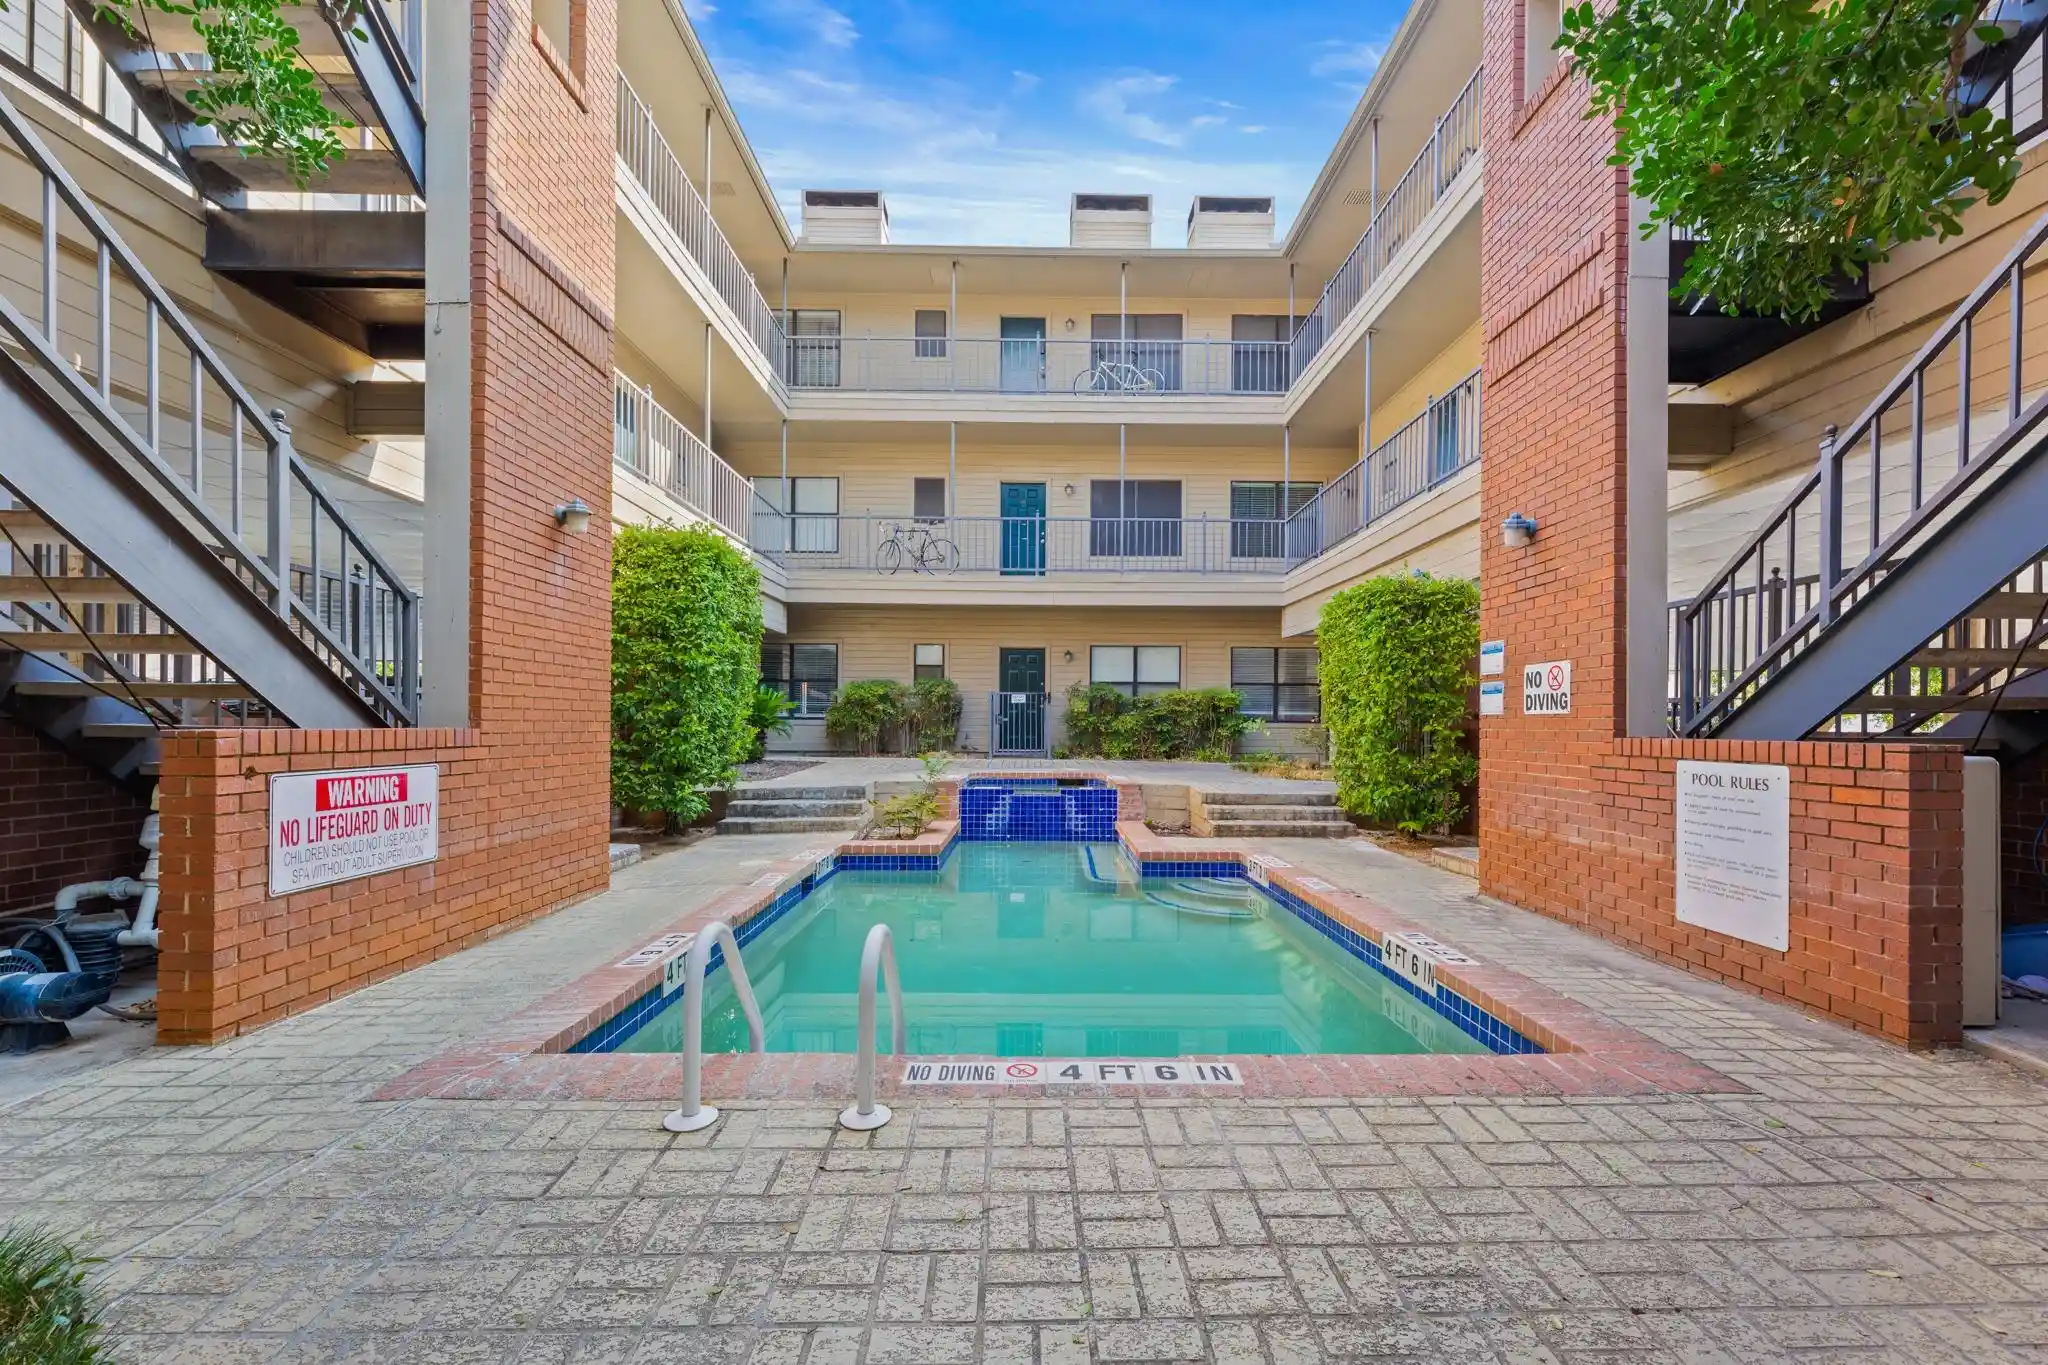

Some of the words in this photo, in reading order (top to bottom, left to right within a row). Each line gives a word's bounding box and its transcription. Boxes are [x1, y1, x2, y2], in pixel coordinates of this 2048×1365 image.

[1525, 671, 1542, 689] NO
[1525, 692, 1568, 711] DIVING
[327, 775, 399, 808] WARNING
[1691, 773, 1725, 788] POOL
[1731, 776, 1770, 792] RULES
[280, 818, 300, 848] NO
[307, 809, 378, 844] LIFEGUARD
[384, 806, 399, 831] ON
[404, 802, 432, 828] DUTY
[284, 846, 330, 867] CHILDREN
[332, 840, 365, 857] SHOULD
[366, 836, 382, 850] NOT
[383, 833, 398, 847] USE
[400, 830, 418, 845] POOL
[419, 828, 429, 842] OR
[292, 867, 310, 884] SPA
[311, 859, 350, 880] WITHOUT
[352, 853, 376, 870] ADULT
[377, 846, 424, 866] SUPERVISION
[666, 960, 674, 984] 4
[677, 951, 688, 979] FT
[1385, 940, 1391, 960] 4
[1395, 944, 1407, 969] FT
[1411, 954, 1418, 976] 6
[1423, 960, 1435, 988] IN
[907, 1064, 932, 1081] NO
[938, 1064, 996, 1081] DIVING
[1059, 1064, 1083, 1080] 4
[1099, 1064, 1136, 1081] FT
[1154, 1065, 1179, 1081] 6
[1196, 1065, 1234, 1081] IN
